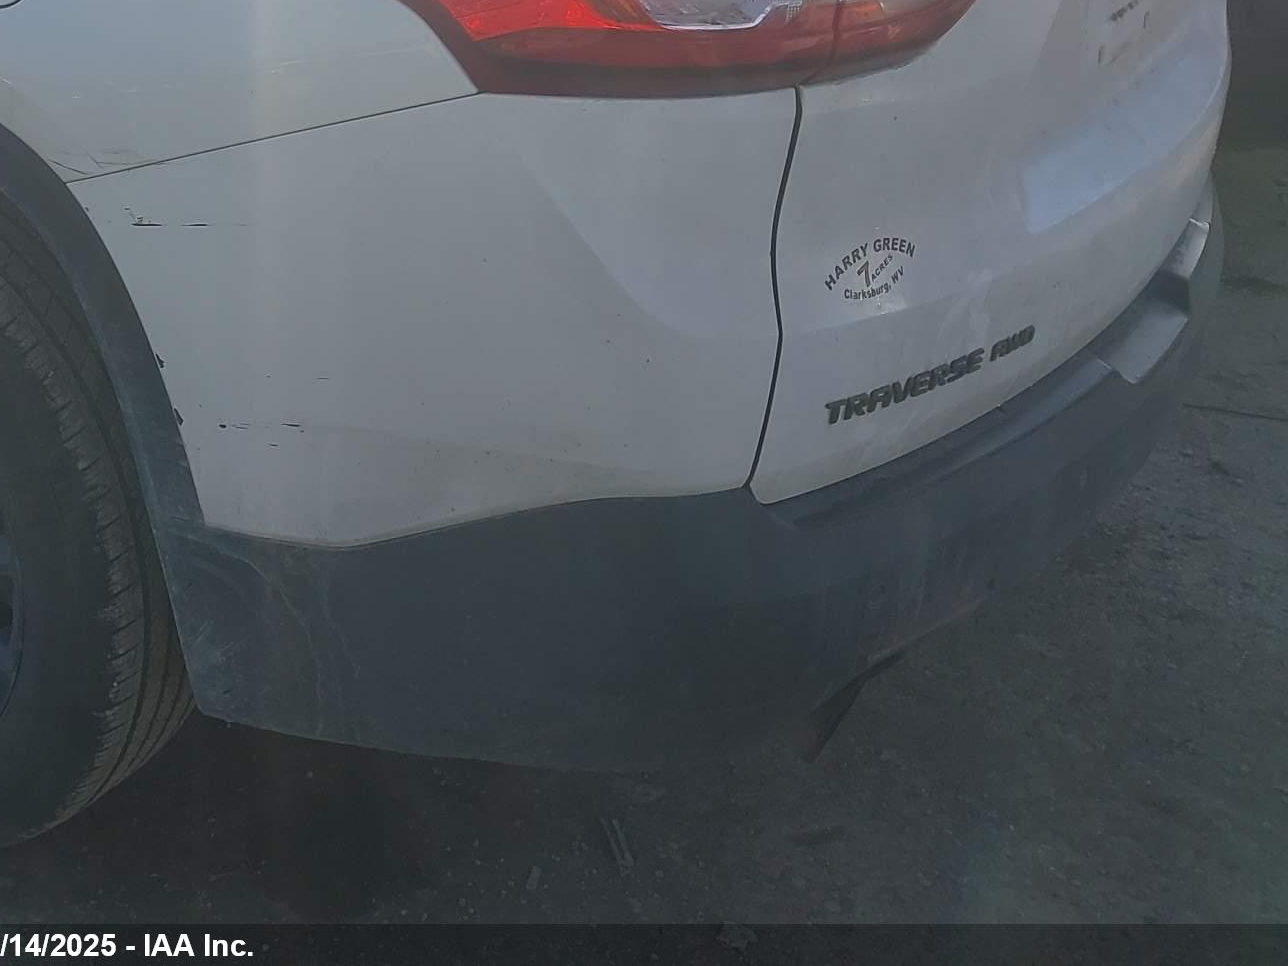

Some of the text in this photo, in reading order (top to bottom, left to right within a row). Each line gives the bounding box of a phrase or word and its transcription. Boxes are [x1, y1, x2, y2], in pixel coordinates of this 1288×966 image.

[824, 237, 916, 290] HARRY GREEN
[844, 265, 904, 300] Clarksburg, WV
[856, 254, 893, 287] 7 ACRES
[825, 325, 1036, 425] TRAVERSE AWD
